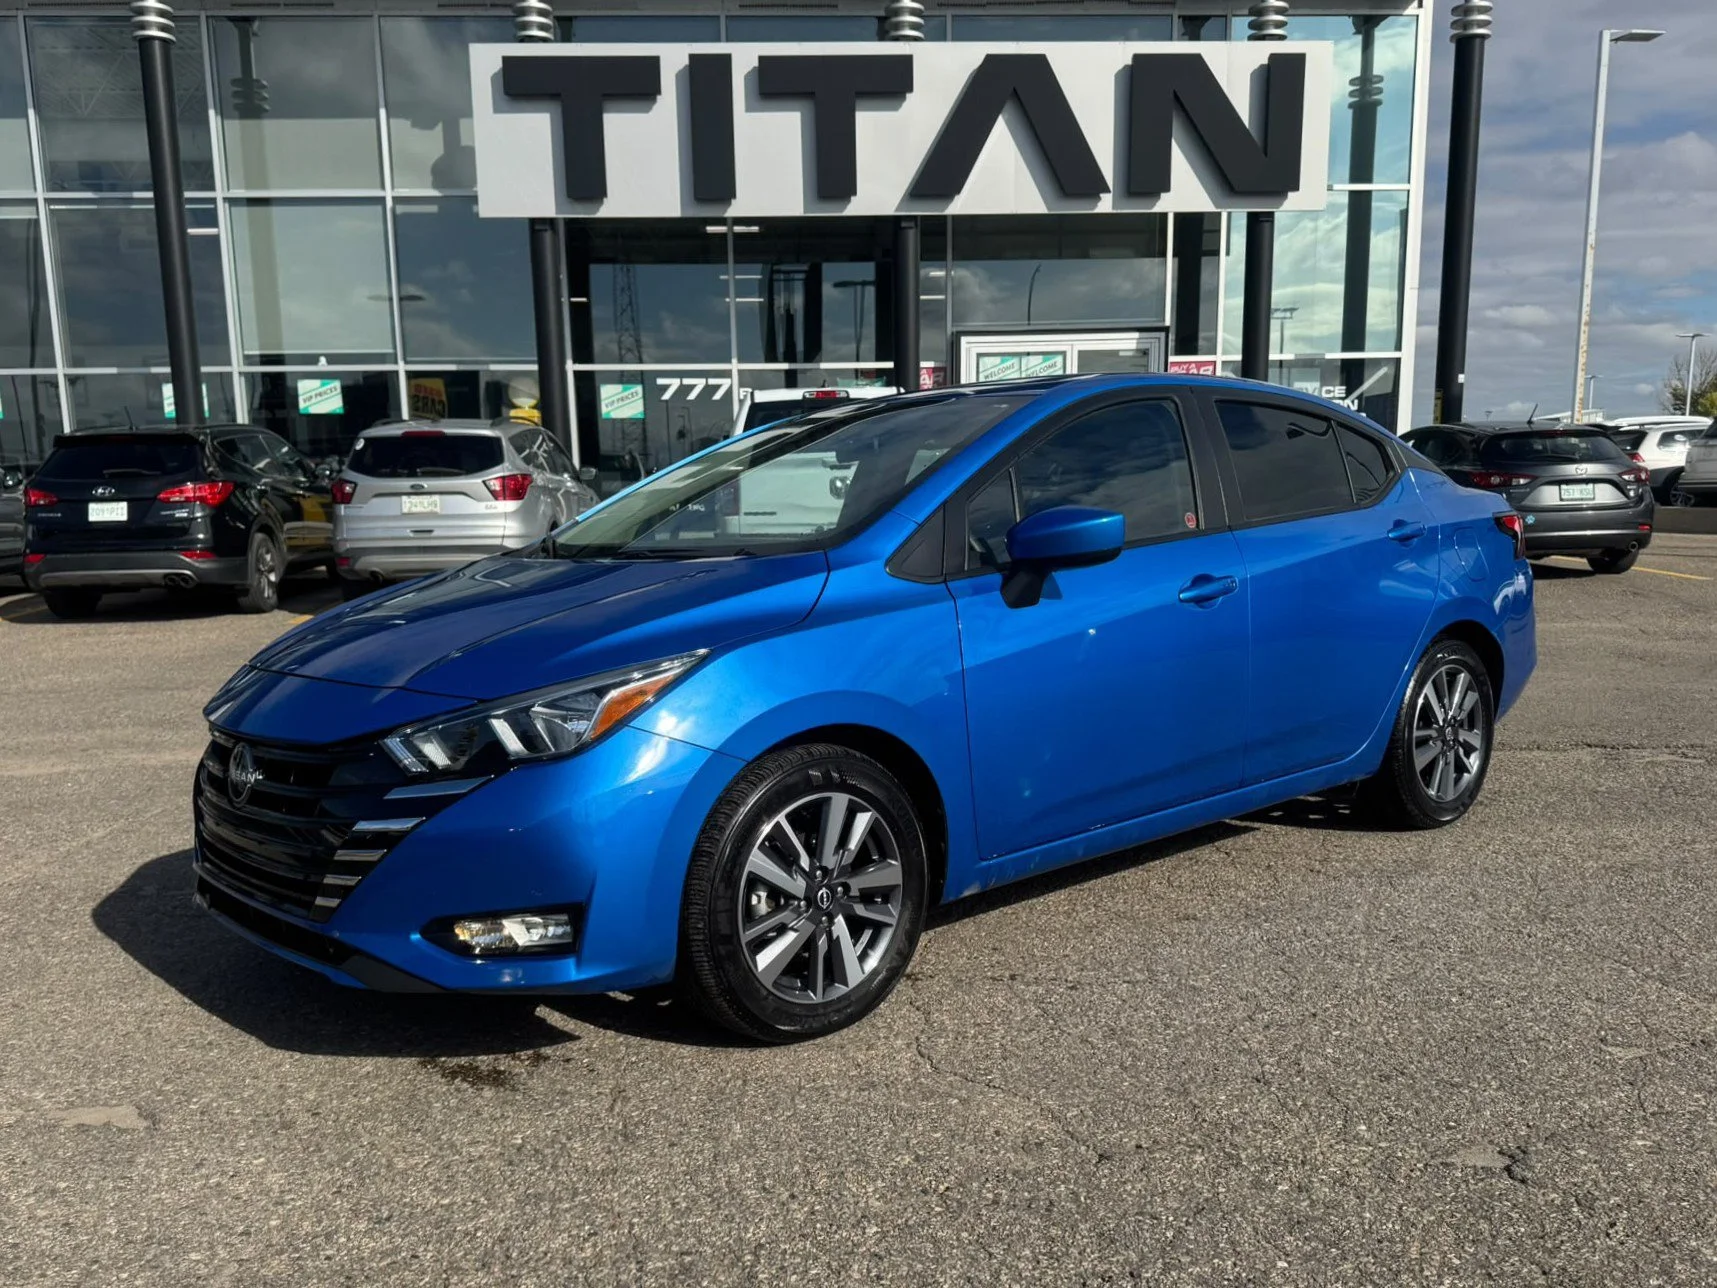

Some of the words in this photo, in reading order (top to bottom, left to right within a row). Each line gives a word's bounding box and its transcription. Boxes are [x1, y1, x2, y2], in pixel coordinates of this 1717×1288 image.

[502, 53, 1306, 200] TITAN
[983, 362, 1016, 381] WELCOME
[302, 395, 315, 405] VIP
[315, 386, 338, 399] PRICES
[616, 390, 639, 404] PRICES
[656, 378, 732, 400] 777
